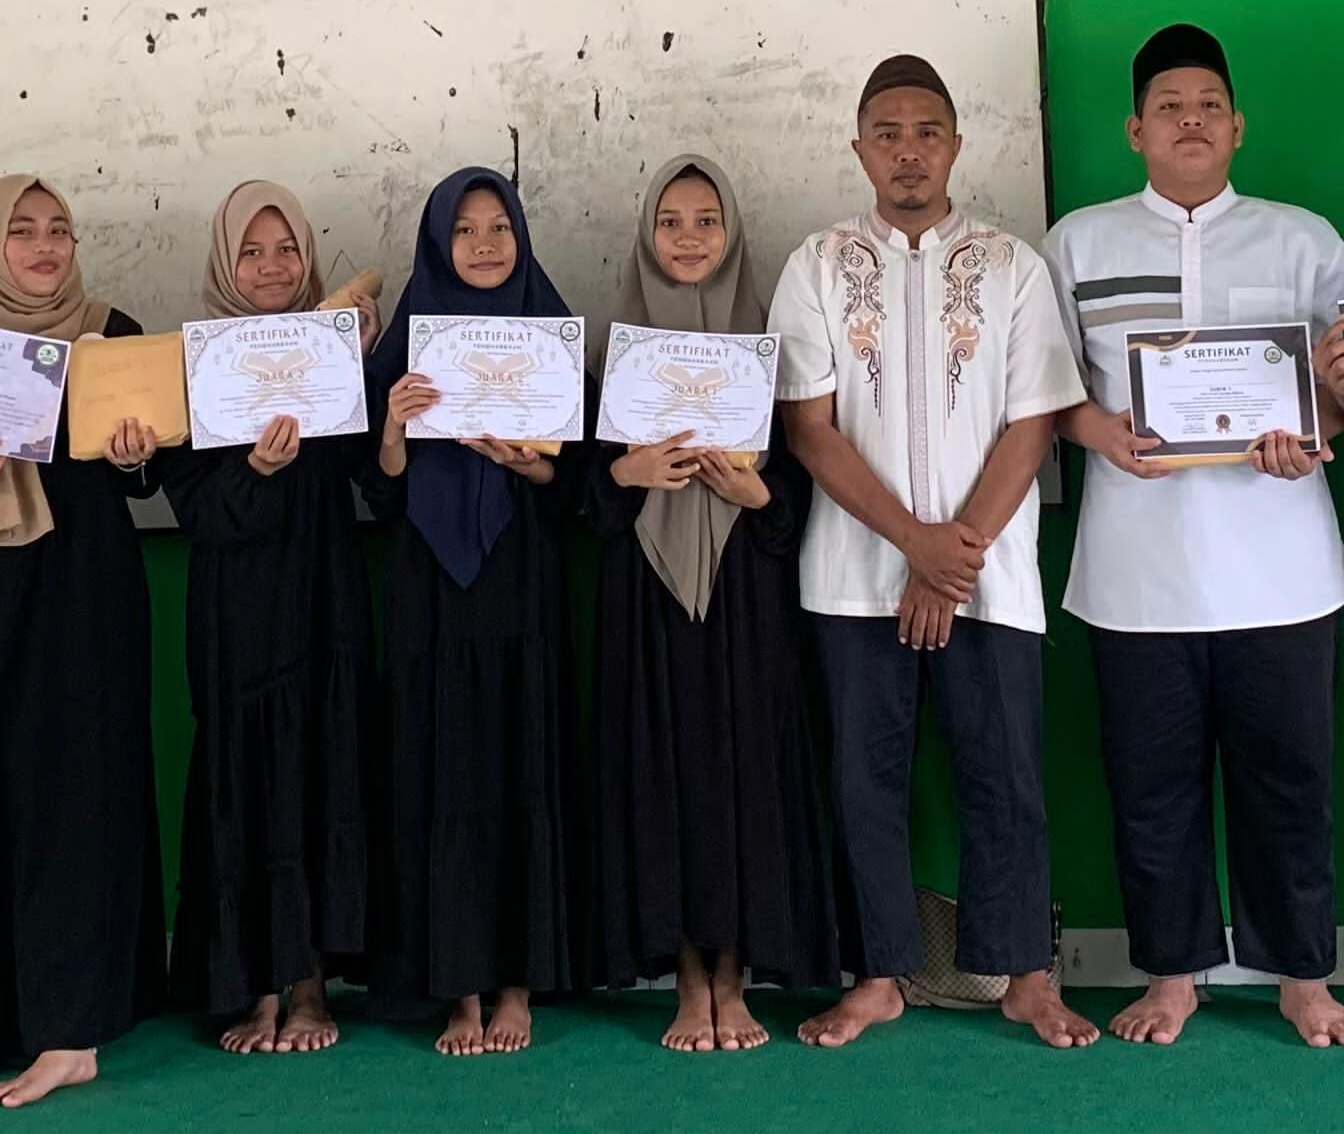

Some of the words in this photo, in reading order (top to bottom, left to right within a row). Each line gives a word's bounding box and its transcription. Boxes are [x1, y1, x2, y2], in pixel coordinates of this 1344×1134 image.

[235, 326, 308, 343] SERTIFIKAT
[460, 331, 533, 342] SERTIFIKAT
[658, 344, 731, 358] SERTIFIKAT
[1184, 346, 1251, 359] SERTIFIKAT
